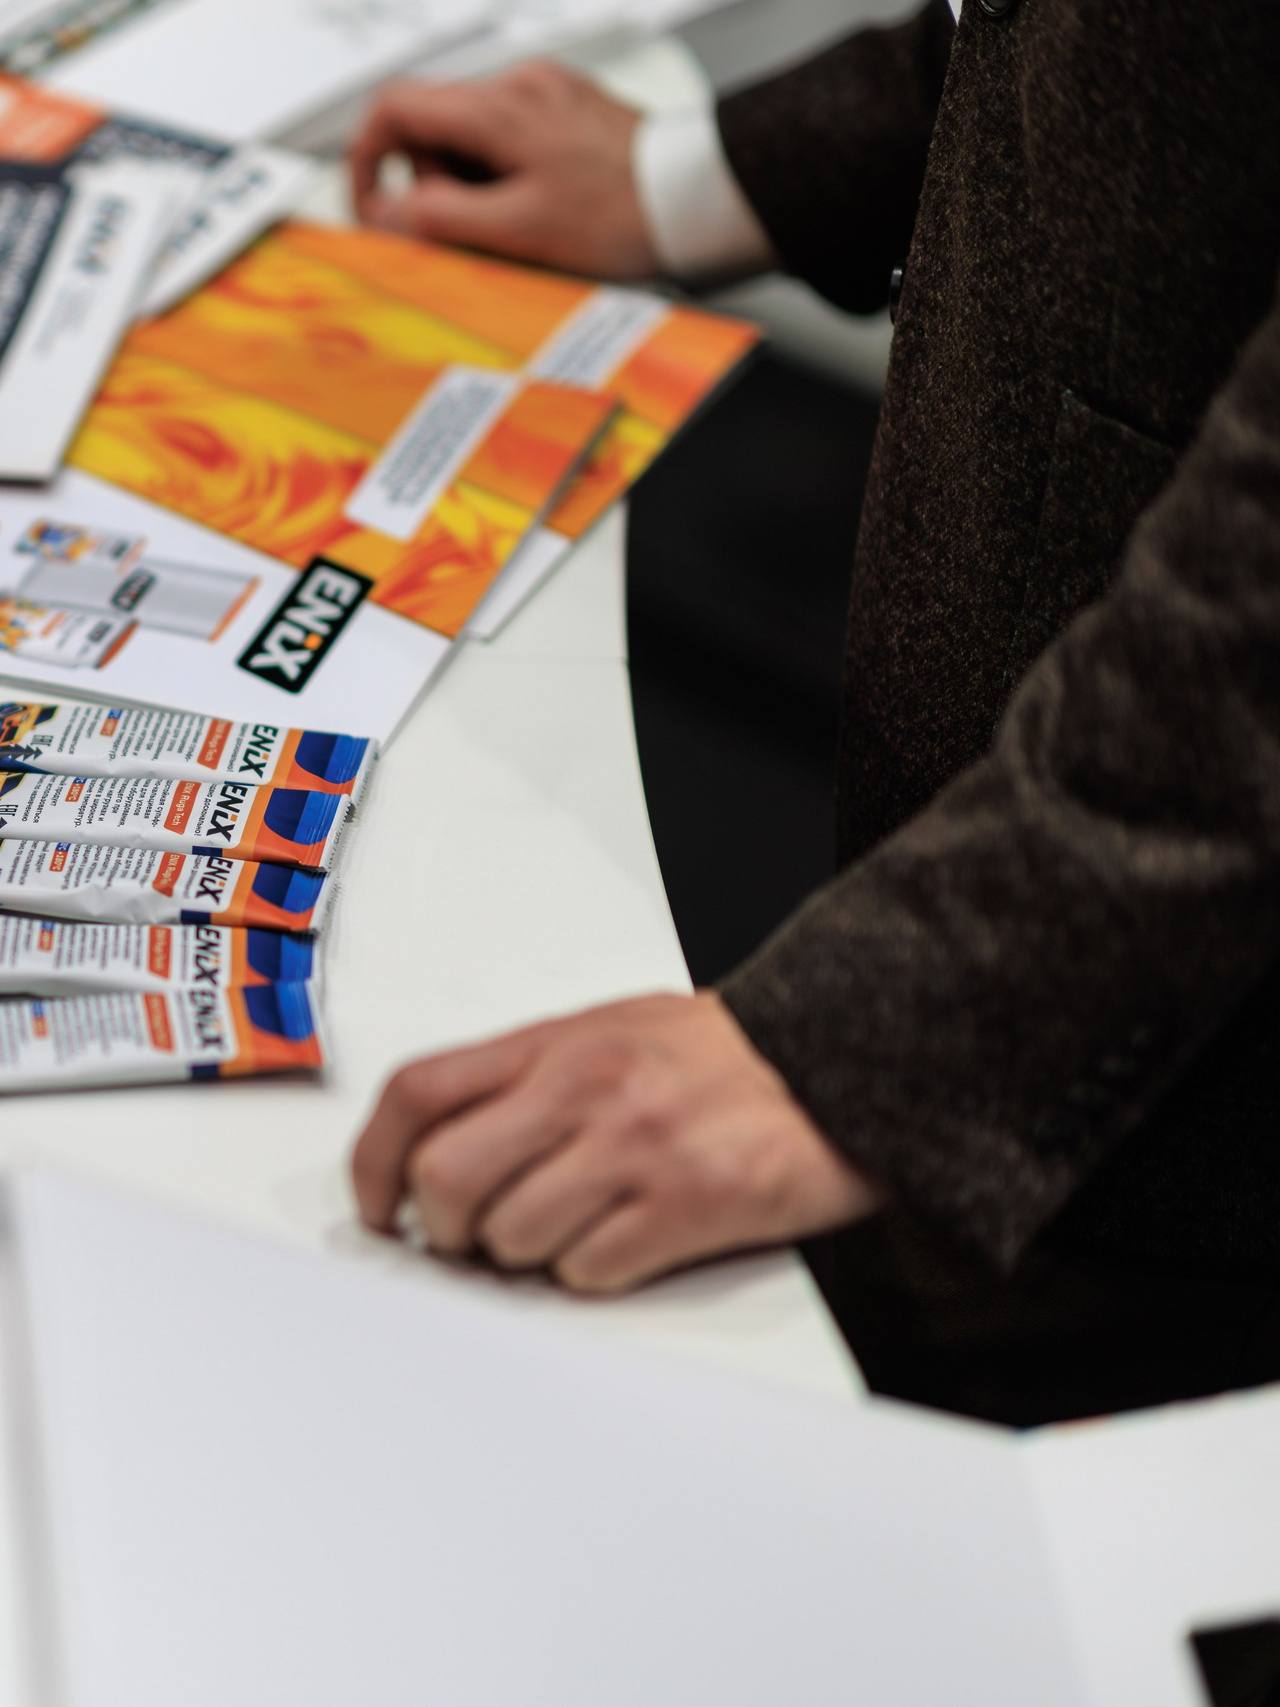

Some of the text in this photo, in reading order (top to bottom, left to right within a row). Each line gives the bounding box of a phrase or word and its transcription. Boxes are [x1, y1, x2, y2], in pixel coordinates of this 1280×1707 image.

[248, 565, 362, 681] ENIX
[238, 724, 278, 779] ENIX
[33, 782, 53, 823] использоваться
[50, 786, 63, 807] продукт
[74, 793, 91, 828] температур.
[87, 798, 100, 824] широком
[101, 789, 113, 816] нагрузках
[112, 804, 120, 813] при
[117, 787, 137, 827] оборудования,
[133, 799, 143, 815] узлов
[172, 782, 195, 826] ENIX Ruga Tech
[206, 785, 248, 842] ENIX
[152, 806, 163, 827] сульфо-
[194, 798, 210, 836] досконально!
[52, 851, 64, 870] +180°C
[195, 856, 234, 905] ENIX
[195, 925, 220, 986] ENIX
[190, 990, 225, 1050] ENIX
